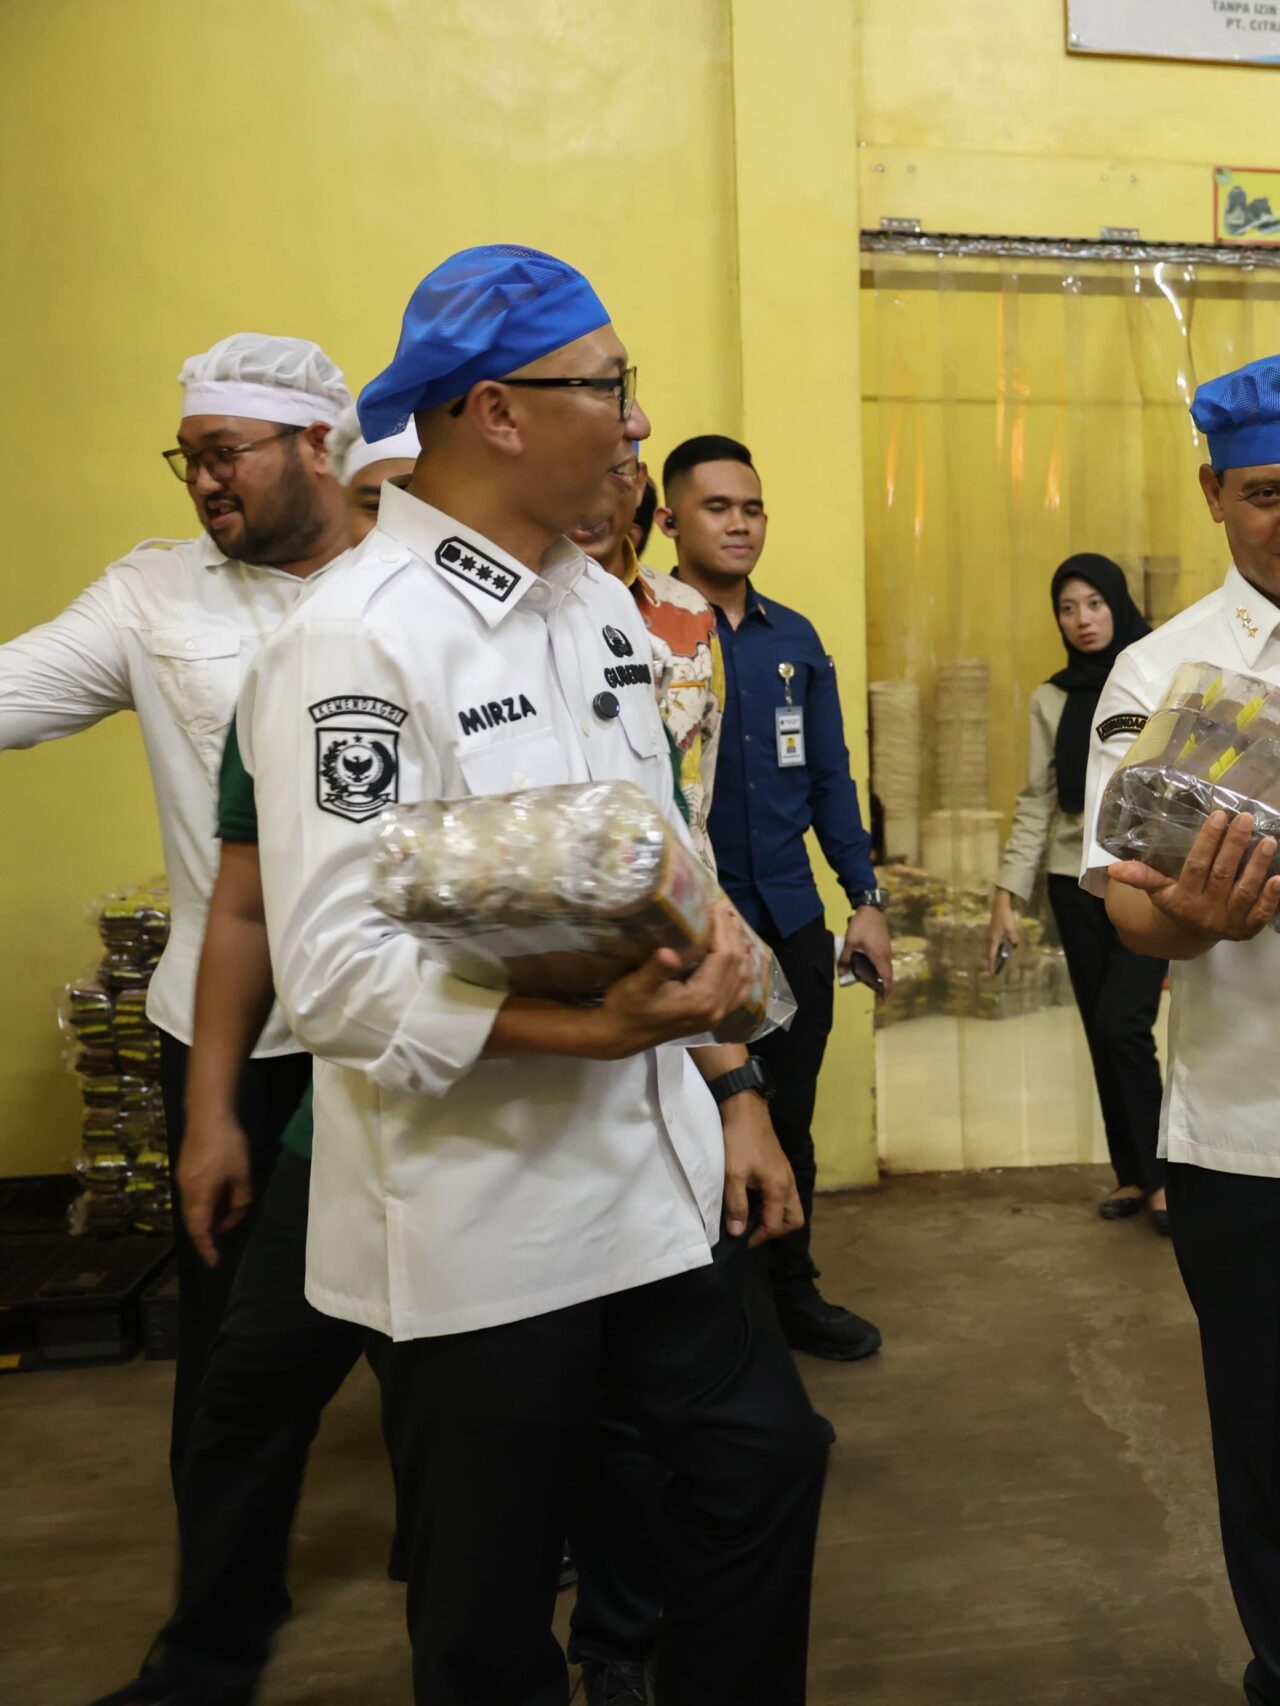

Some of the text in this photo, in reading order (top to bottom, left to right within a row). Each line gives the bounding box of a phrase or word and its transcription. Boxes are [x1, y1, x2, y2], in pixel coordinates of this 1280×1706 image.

[1211, 1, 1249, 14] TANPA
[1254, 3, 1277, 16] IZIN
[1226, 17, 1246, 30] PT.
[458, 693, 537, 736] MIRZA
